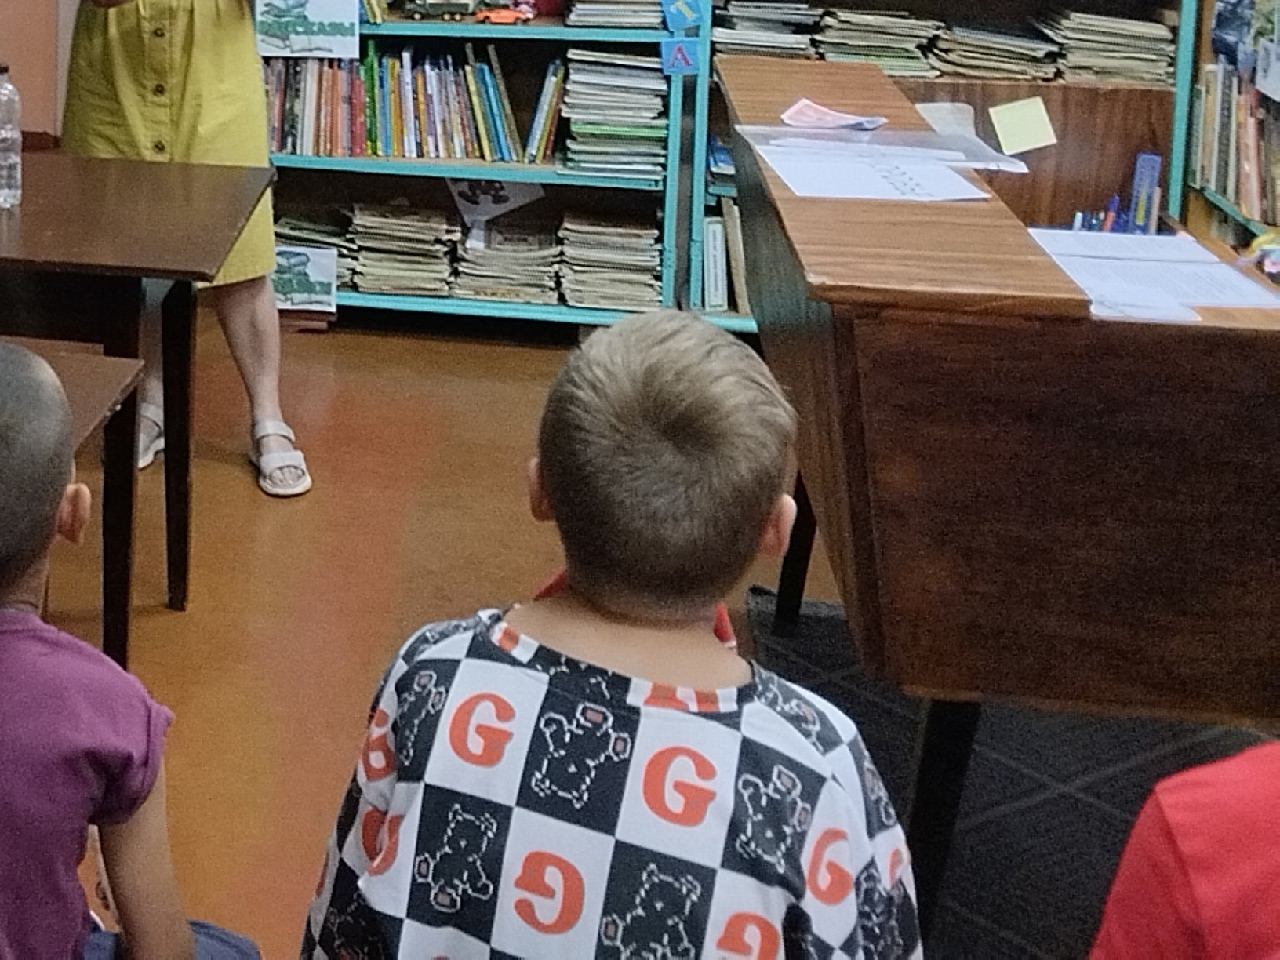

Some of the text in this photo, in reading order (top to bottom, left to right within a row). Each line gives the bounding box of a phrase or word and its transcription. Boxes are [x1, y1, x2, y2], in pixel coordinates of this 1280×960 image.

[448, 691, 516, 767] G
[641, 745, 718, 827] G
[513, 850, 586, 935] G
